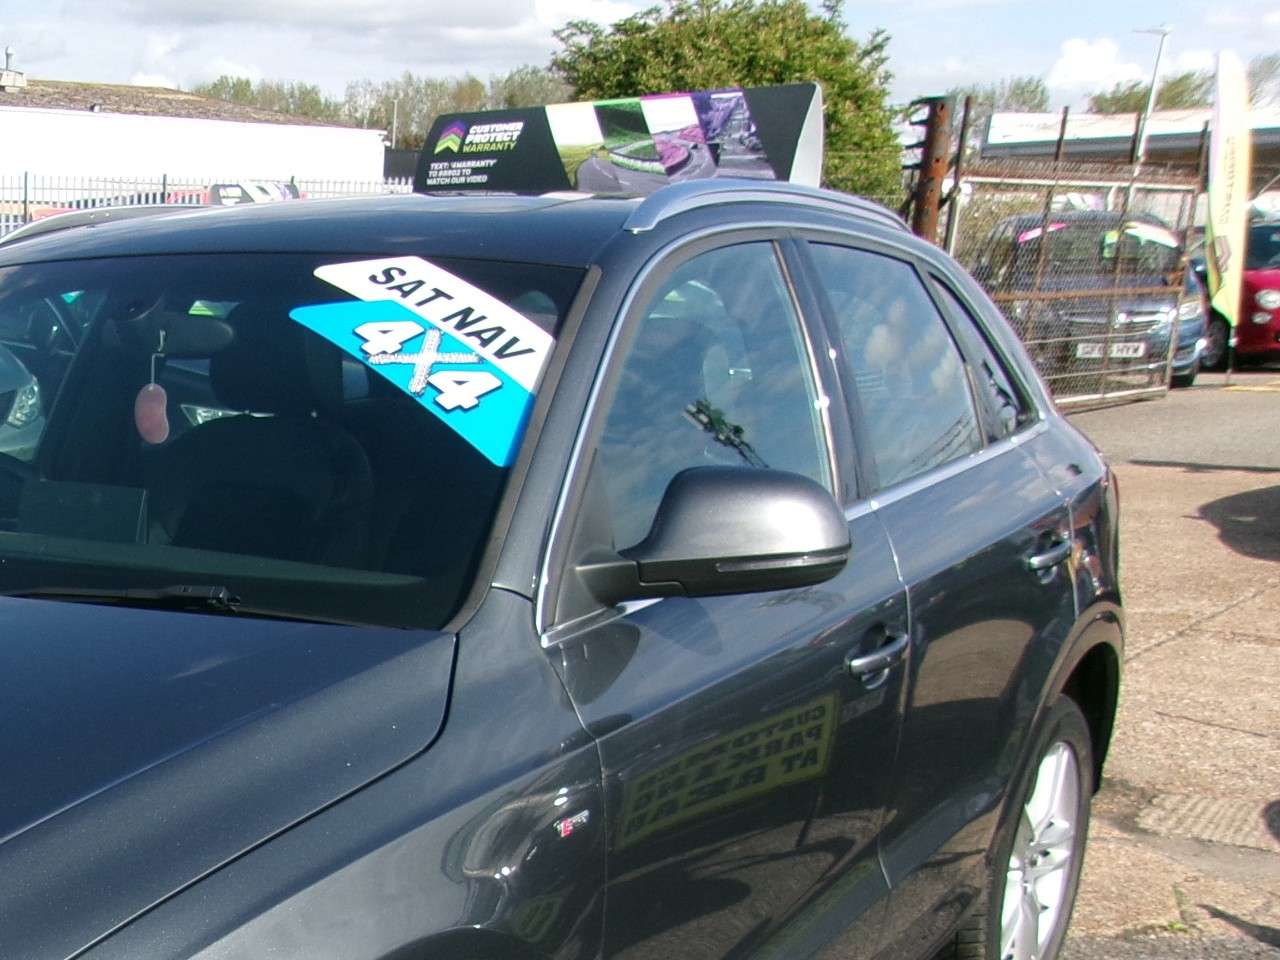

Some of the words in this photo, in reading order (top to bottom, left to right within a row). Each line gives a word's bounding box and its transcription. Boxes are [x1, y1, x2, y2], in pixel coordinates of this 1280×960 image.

[468, 121, 524, 134] CUSTOMER
[464, 131, 521, 145] PROTECT
[463, 141, 517, 153] WARRANTY
[368, 266, 454, 307] SAT
[441, 306, 536, 360] NAV
